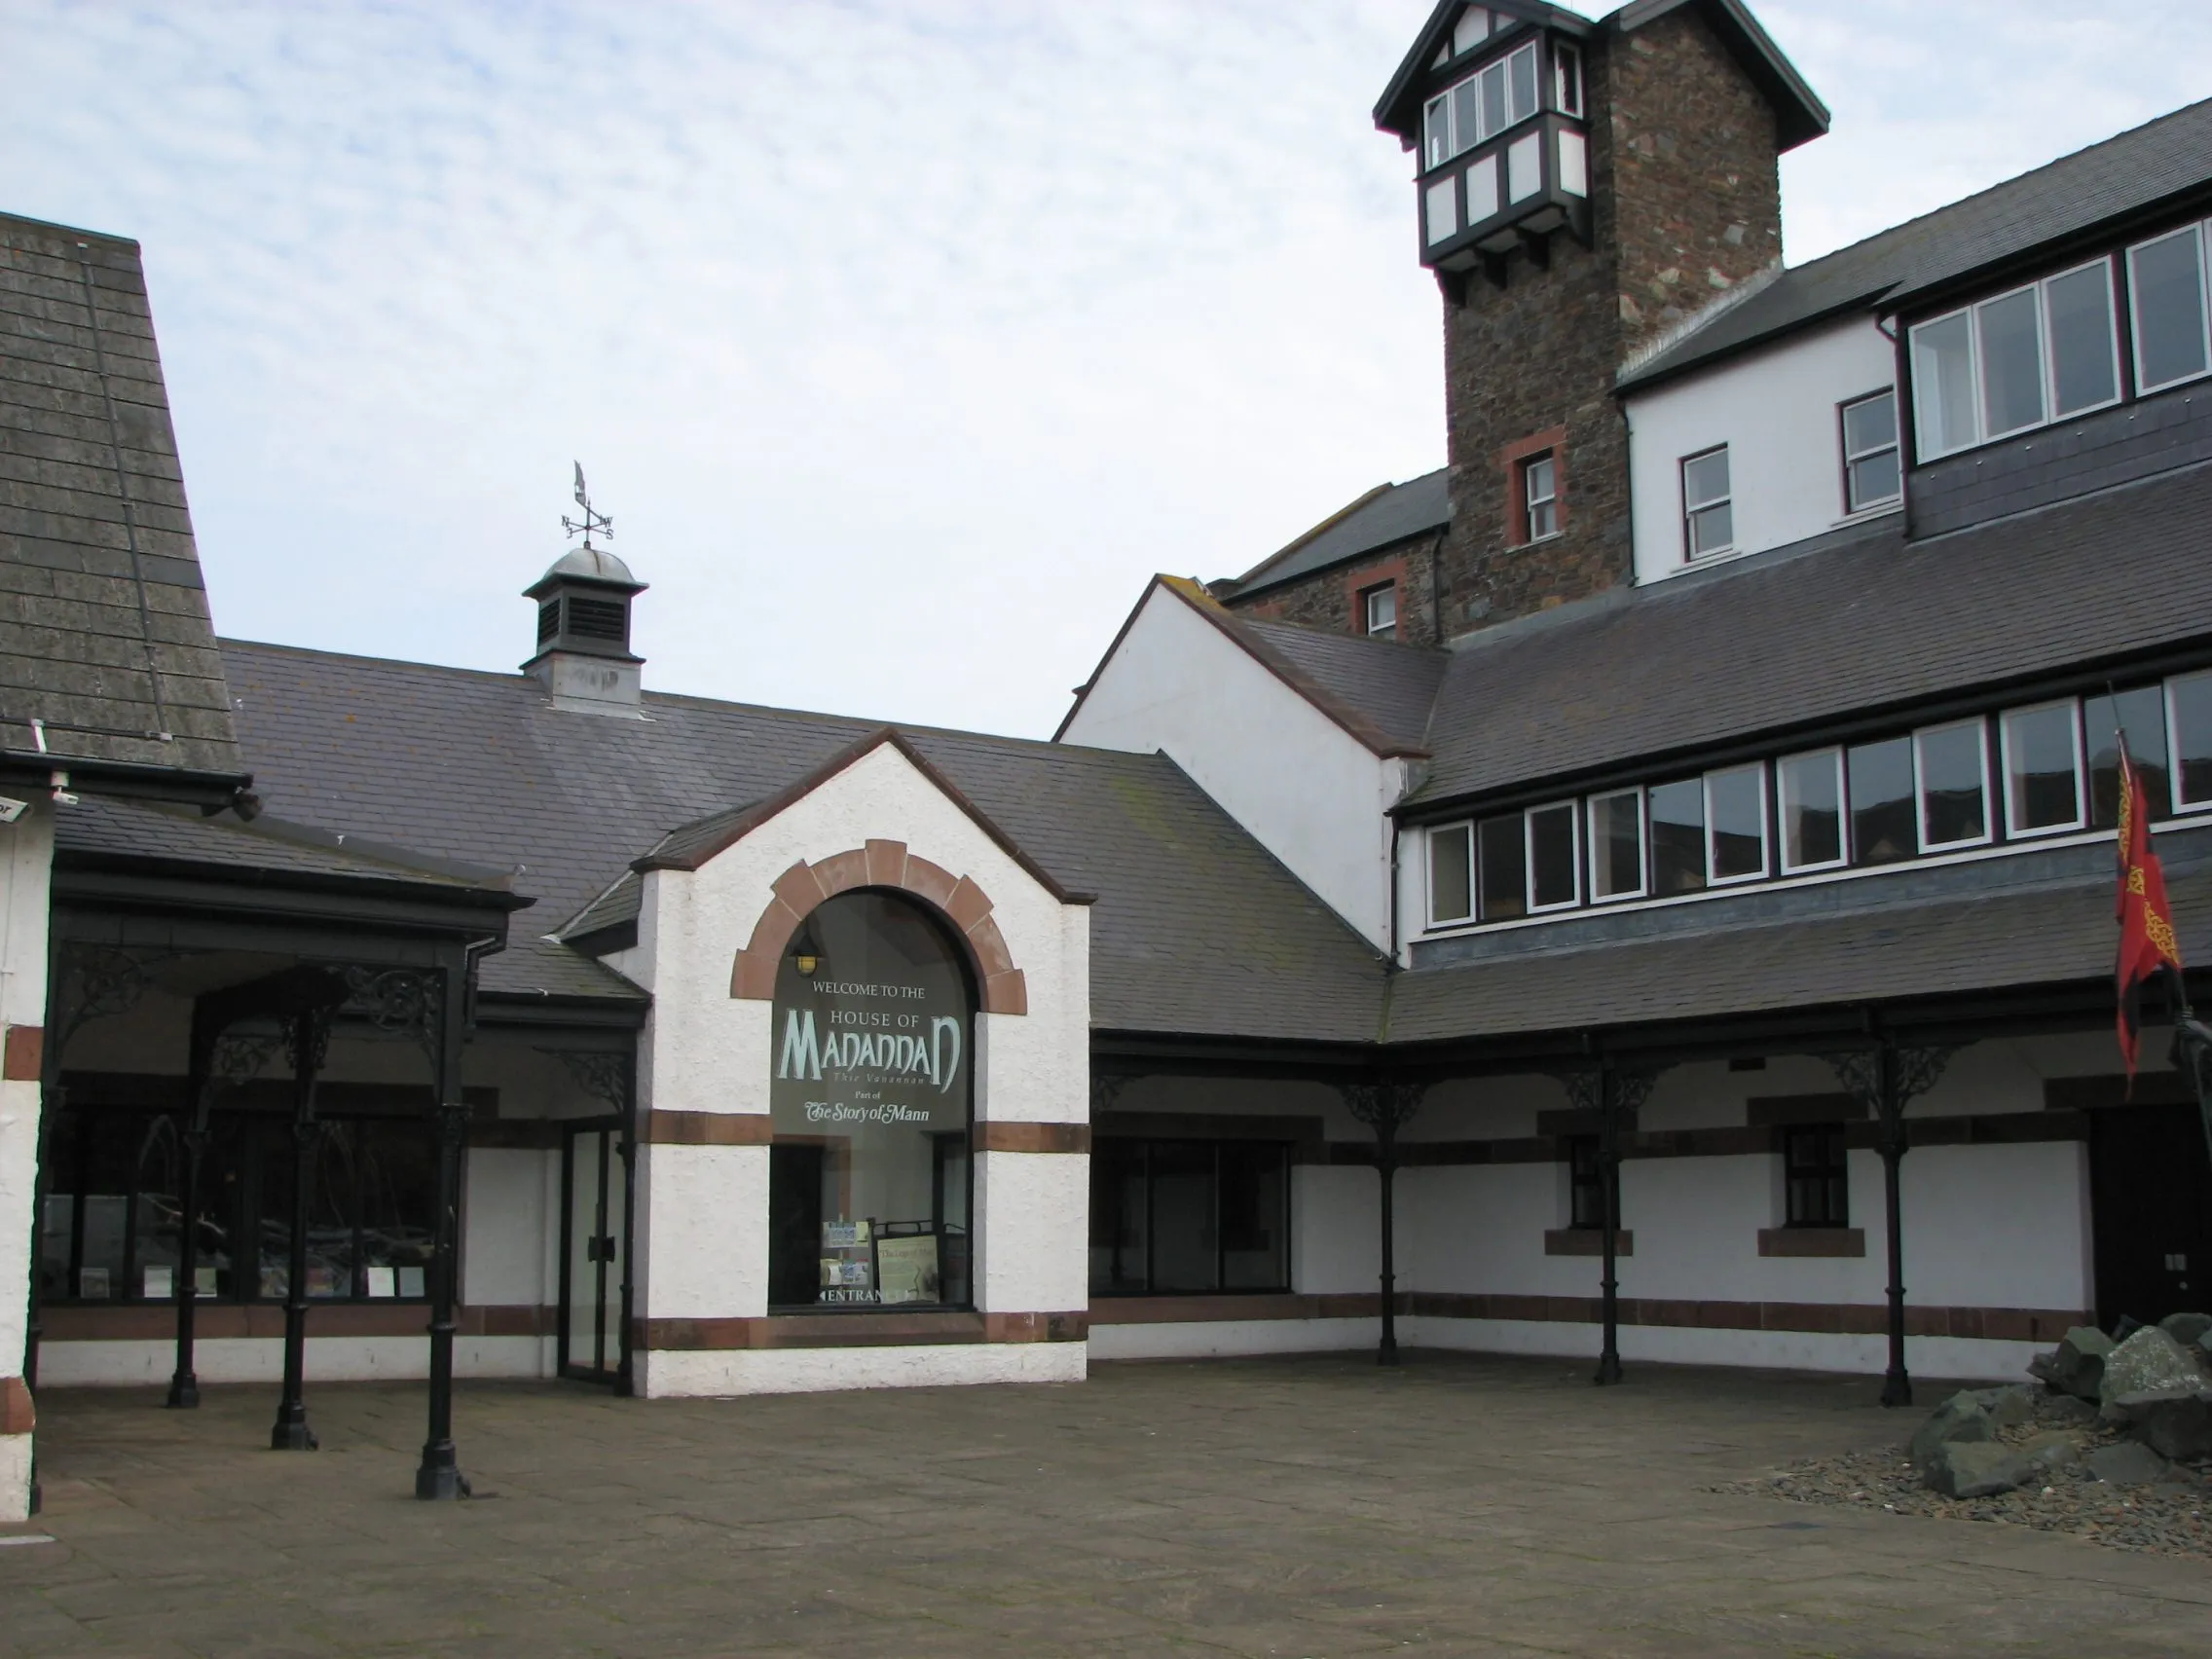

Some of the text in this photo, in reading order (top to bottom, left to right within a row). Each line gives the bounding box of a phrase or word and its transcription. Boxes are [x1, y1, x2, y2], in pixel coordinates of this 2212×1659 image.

[813, 980, 925, 999] WELCOME TO THE
[830, 1011, 919, 1027] HOUSE OF
[778, 1009, 961, 1093] MANANNAN
[804, 1101, 930, 1124] The Story of Mann
